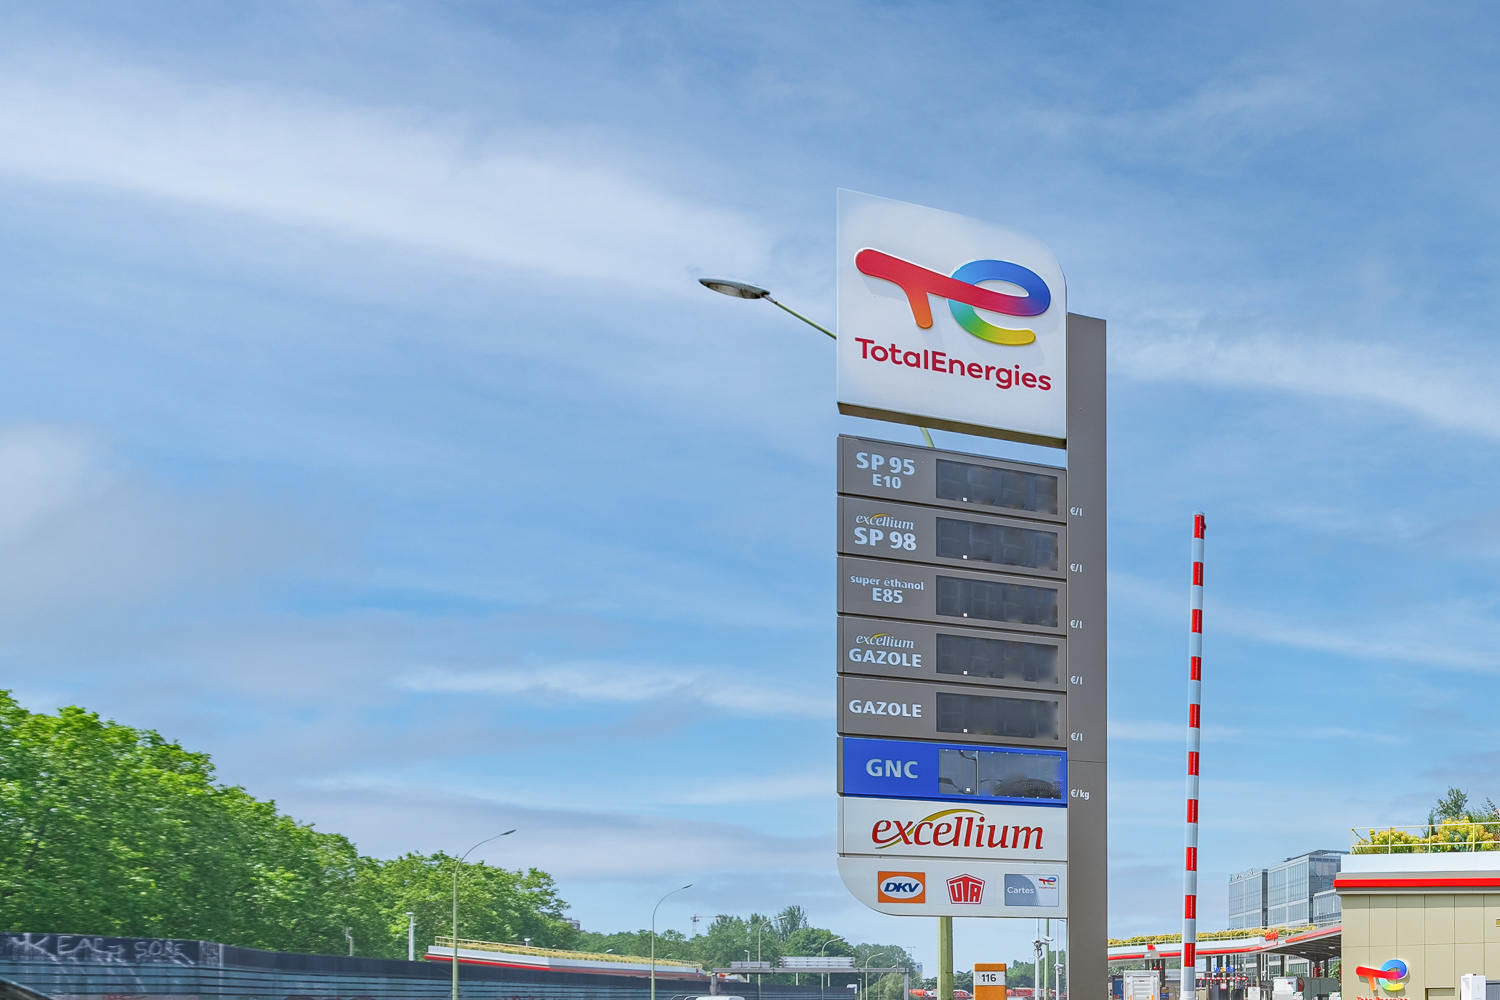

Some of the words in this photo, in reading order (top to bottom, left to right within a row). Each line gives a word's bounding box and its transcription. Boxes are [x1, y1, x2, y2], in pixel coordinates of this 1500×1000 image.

[854, 337, 1052, 391] TotalEnergies
[856, 452, 885, 471] SP
[889, 456, 916, 476] 95
[872, 473, 902, 489] E10
[855, 514, 914, 530] excellium
[853, 526, 884, 547] SP
[889, 531, 917, 551] 98
[850, 575, 881, 587] super
[883, 578, 924, 591] éthanol
[872, 587, 904, 604] E85
[855, 634, 915, 649] excellium
[848, 648, 922, 668] GAZOLE
[848, 699, 922, 718] GAZOLE
[865, 758, 919, 779] GNC
[1070, 788, 1090, 800] €/kg
[871, 813, 1044, 850] excellium
[883, 881, 920, 893] DKV
[949, 877, 983, 902] UTA
[1007, 886, 1035, 894] Cartes
[981, 973, 997, 983] 116
